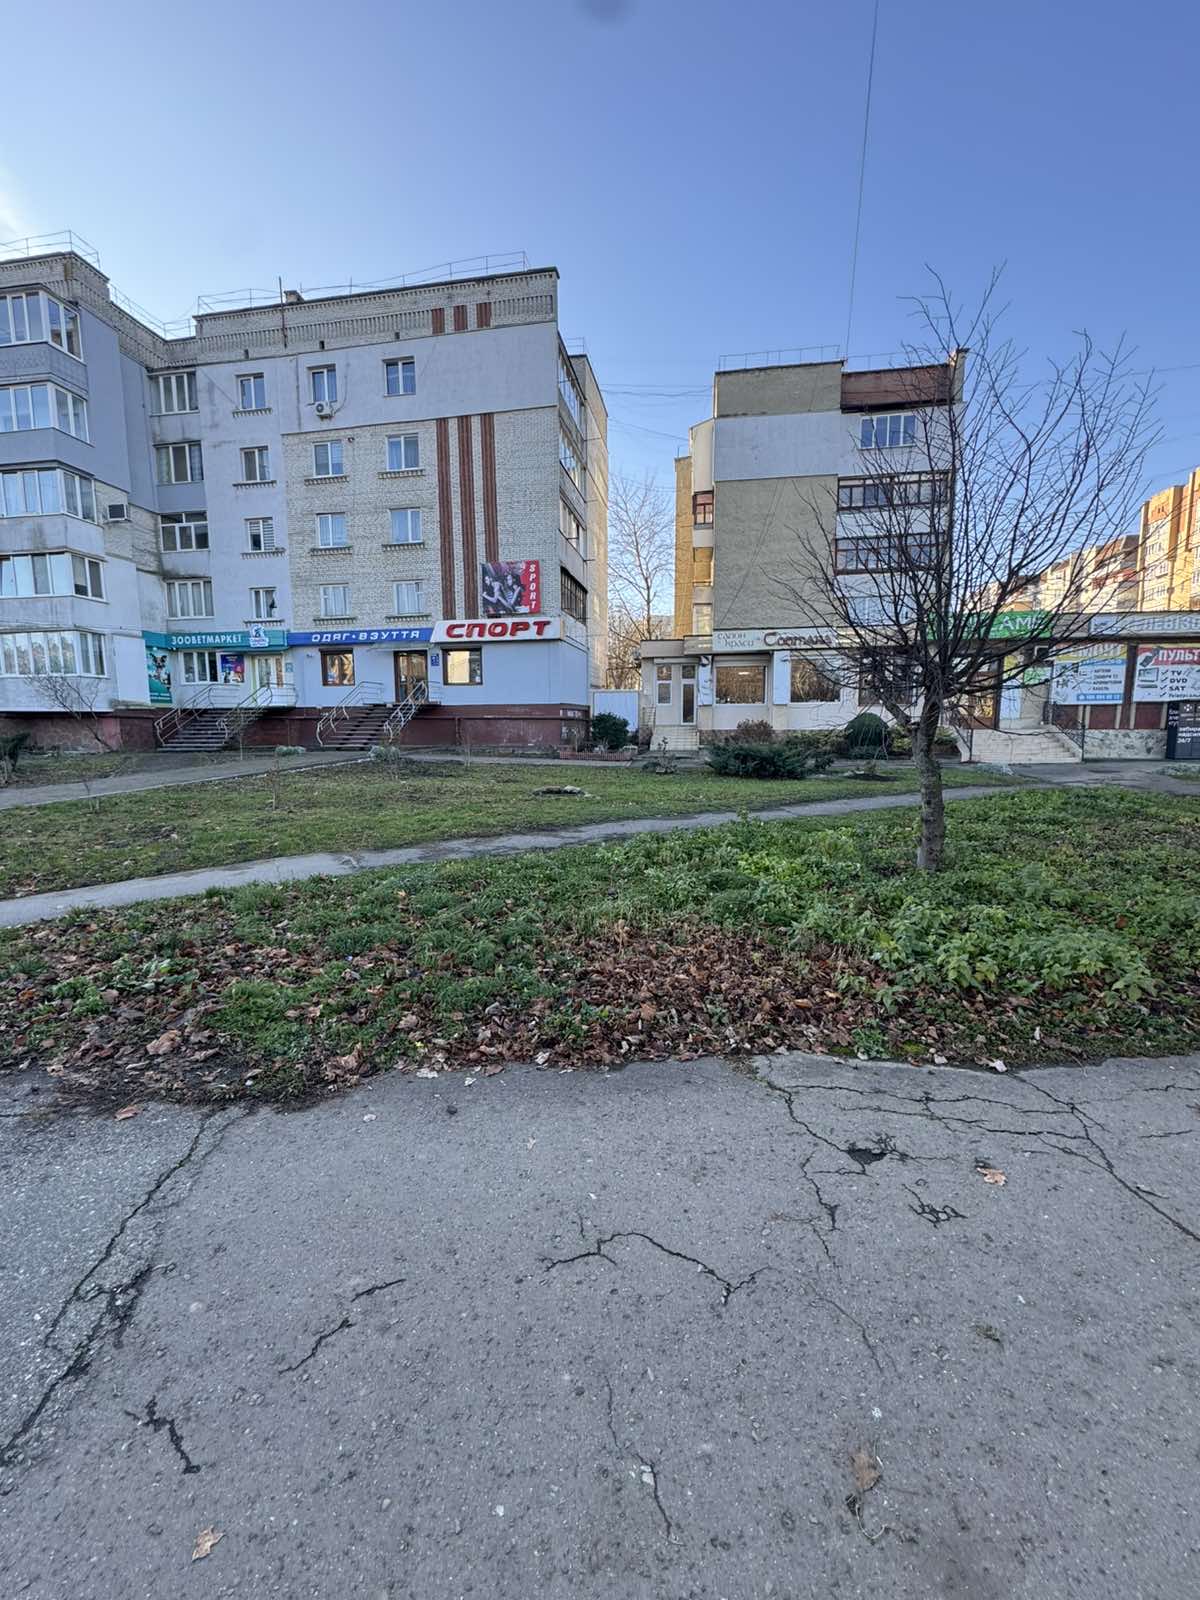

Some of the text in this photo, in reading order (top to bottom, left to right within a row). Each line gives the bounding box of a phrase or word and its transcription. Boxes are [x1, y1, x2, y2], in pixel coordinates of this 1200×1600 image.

[446, 620, 551, 639] СПОРТ
[171, 634, 243, 645] ЗООВЕТМАРКЕТ
[311, 630, 420, 642] ОДЯГ ВЗУТТЯ
